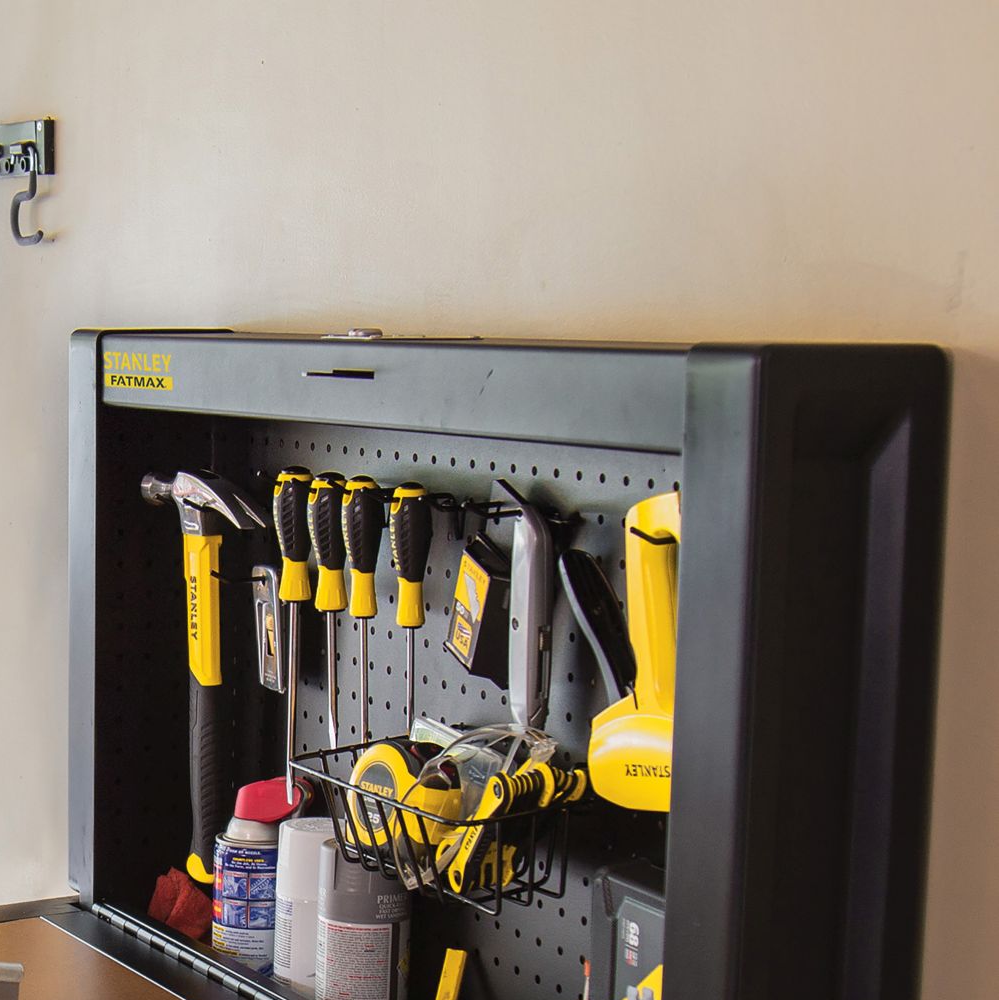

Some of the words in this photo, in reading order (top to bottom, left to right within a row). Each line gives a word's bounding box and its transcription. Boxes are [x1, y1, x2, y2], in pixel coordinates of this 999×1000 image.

[103, 351, 171, 373] STANLEY
[110, 375, 166, 389] FATMAX
[389, 516, 403, 572] STANLEY
[189, 575, 199, 641] STANLEY
[455, 632, 469, 649] USA
[624, 764, 672, 779] STANLEY
[361, 781, 395, 799] STANLEY
[628, 921, 640, 948] 68
